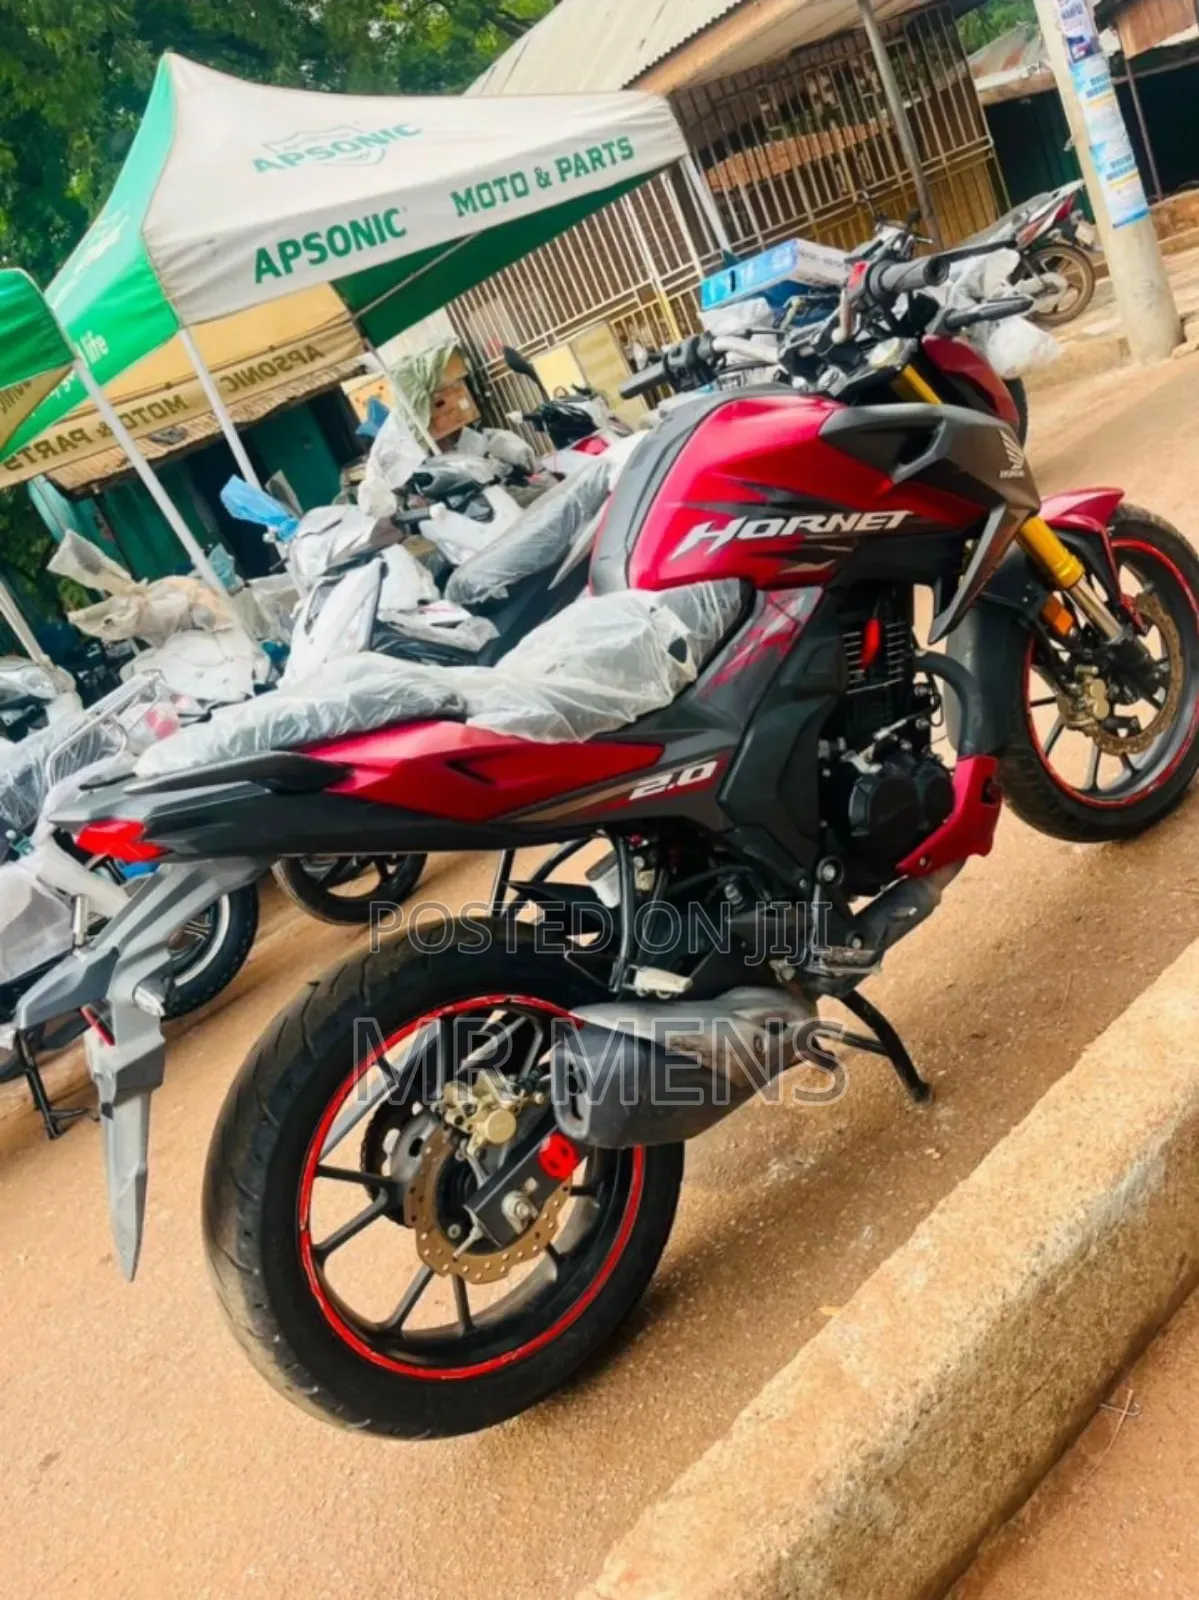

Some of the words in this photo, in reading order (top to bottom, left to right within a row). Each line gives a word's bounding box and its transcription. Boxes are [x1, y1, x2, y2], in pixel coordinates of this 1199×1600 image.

[252, 123, 422, 173] APSONIC
[255, 207, 407, 284] APSONIC
[451, 171, 530, 217] MOTO
[534, 166, 553, 189] &
[555, 136, 635, 183] PARTS
[670, 510, 914, 561] HORNET
[628, 760, 718, 801] 2.0
